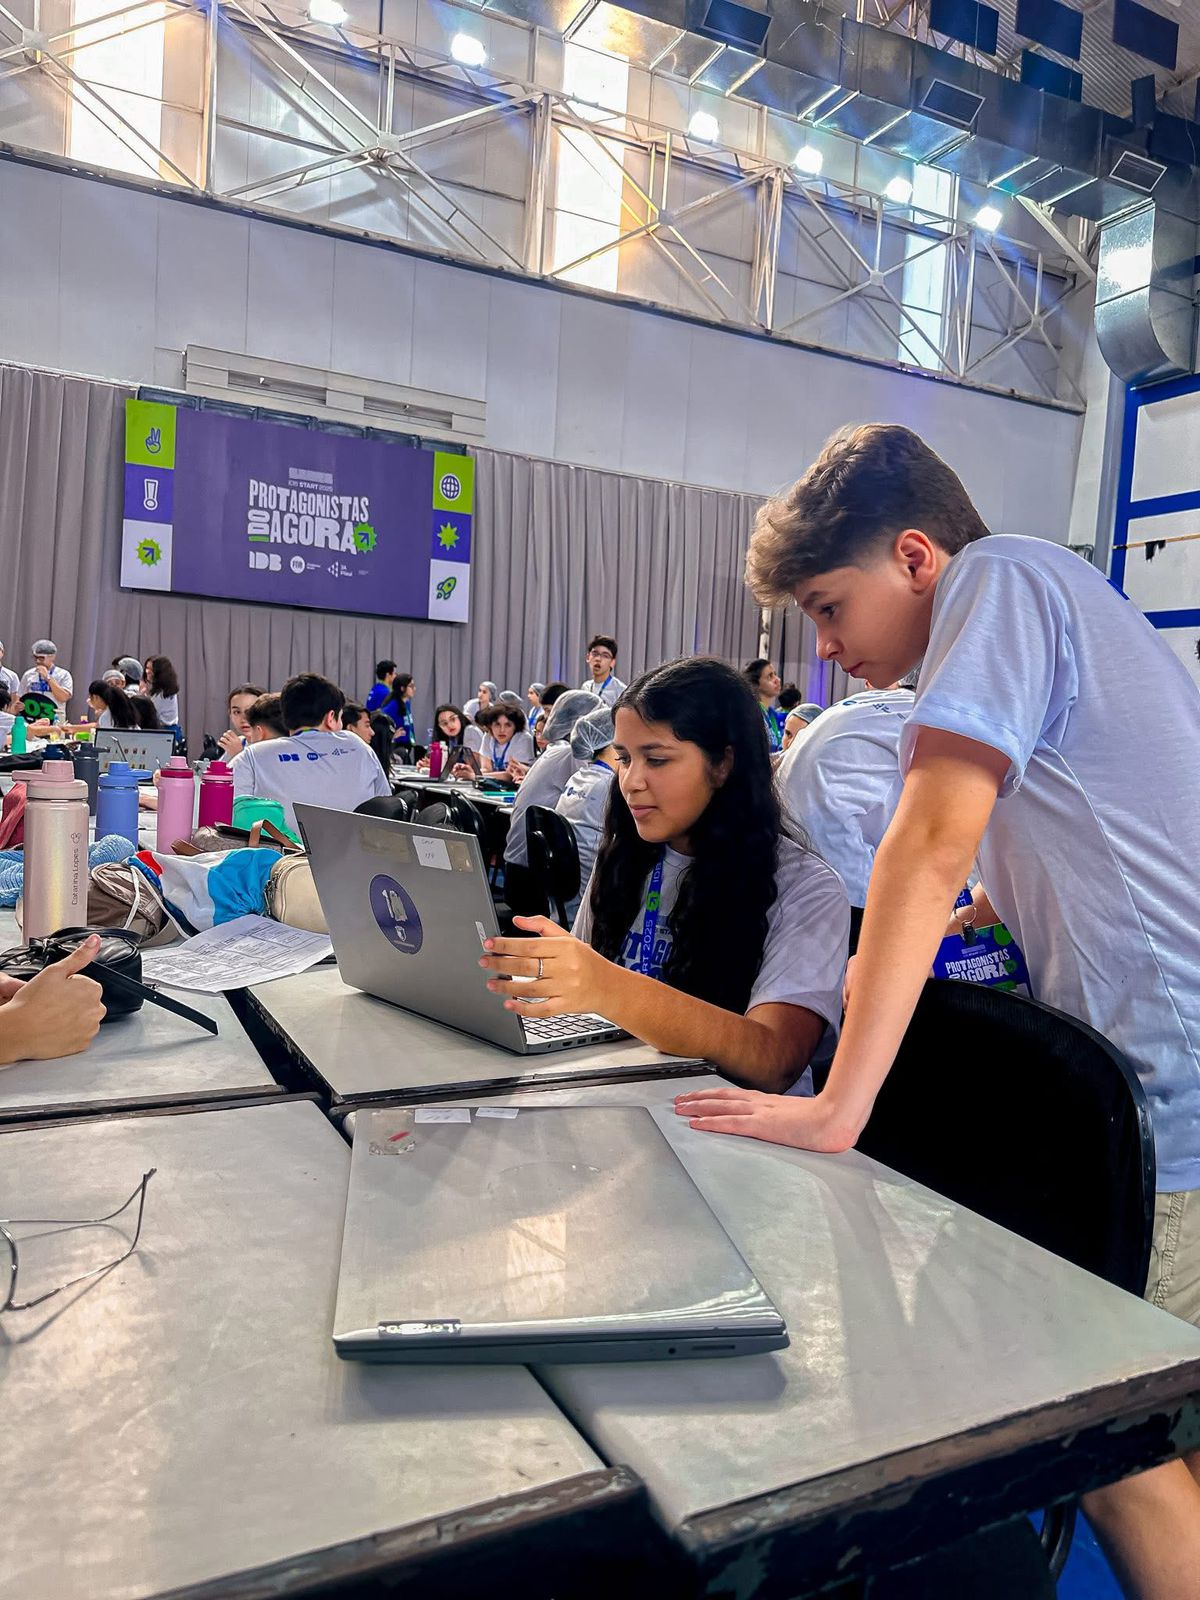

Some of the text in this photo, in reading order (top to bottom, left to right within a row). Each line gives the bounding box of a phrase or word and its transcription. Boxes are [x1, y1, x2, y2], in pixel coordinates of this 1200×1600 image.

[300, 482, 319, 490] START
[249, 479, 369, 523] PROTAGONISTAS
[270, 510, 357, 555] AGORA
[249, 551, 282, 571] IDB
[643, 919, 654, 952] 2025
[641, 957, 651, 976] RT
[945, 948, 1010, 975] PROTAGONISTAS
[960, 962, 1009, 982] AGORA
